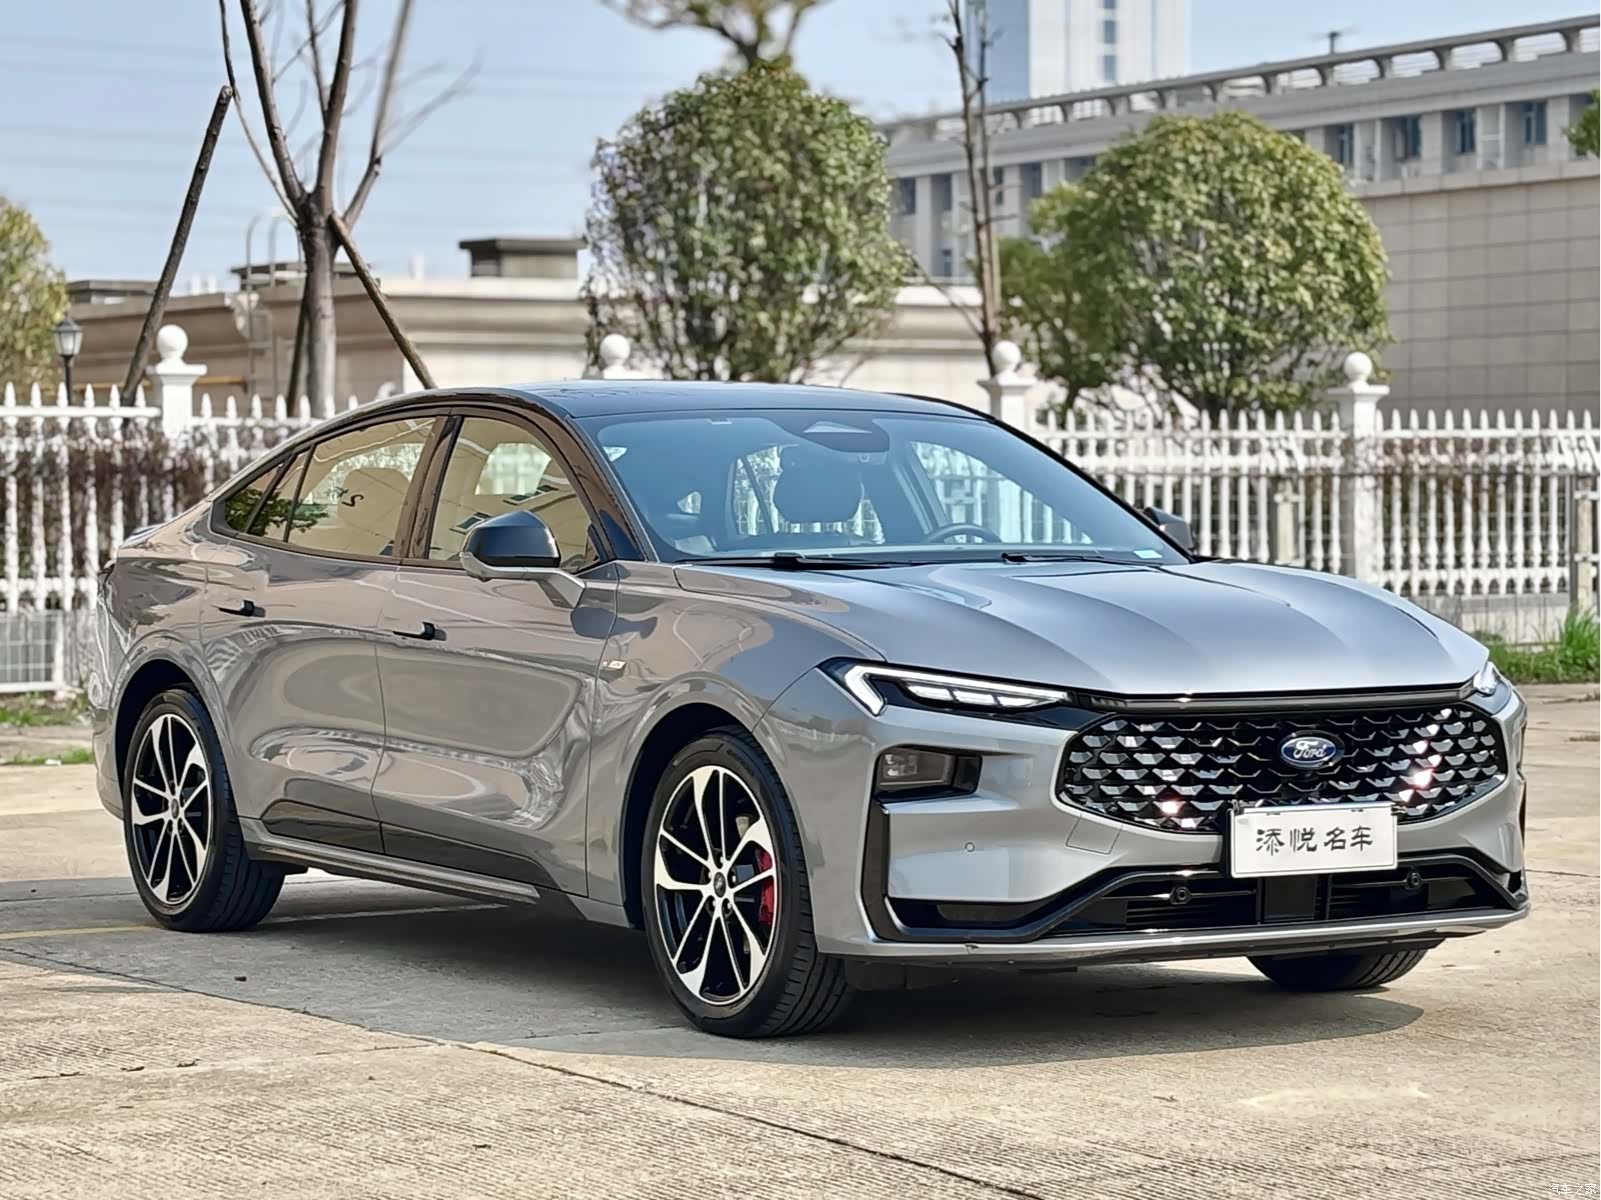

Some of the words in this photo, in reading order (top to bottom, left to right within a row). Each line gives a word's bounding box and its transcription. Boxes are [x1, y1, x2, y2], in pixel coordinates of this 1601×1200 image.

[1293, 740, 1327, 759] Ford
[1256, 825, 1373, 856] 添悦名车
